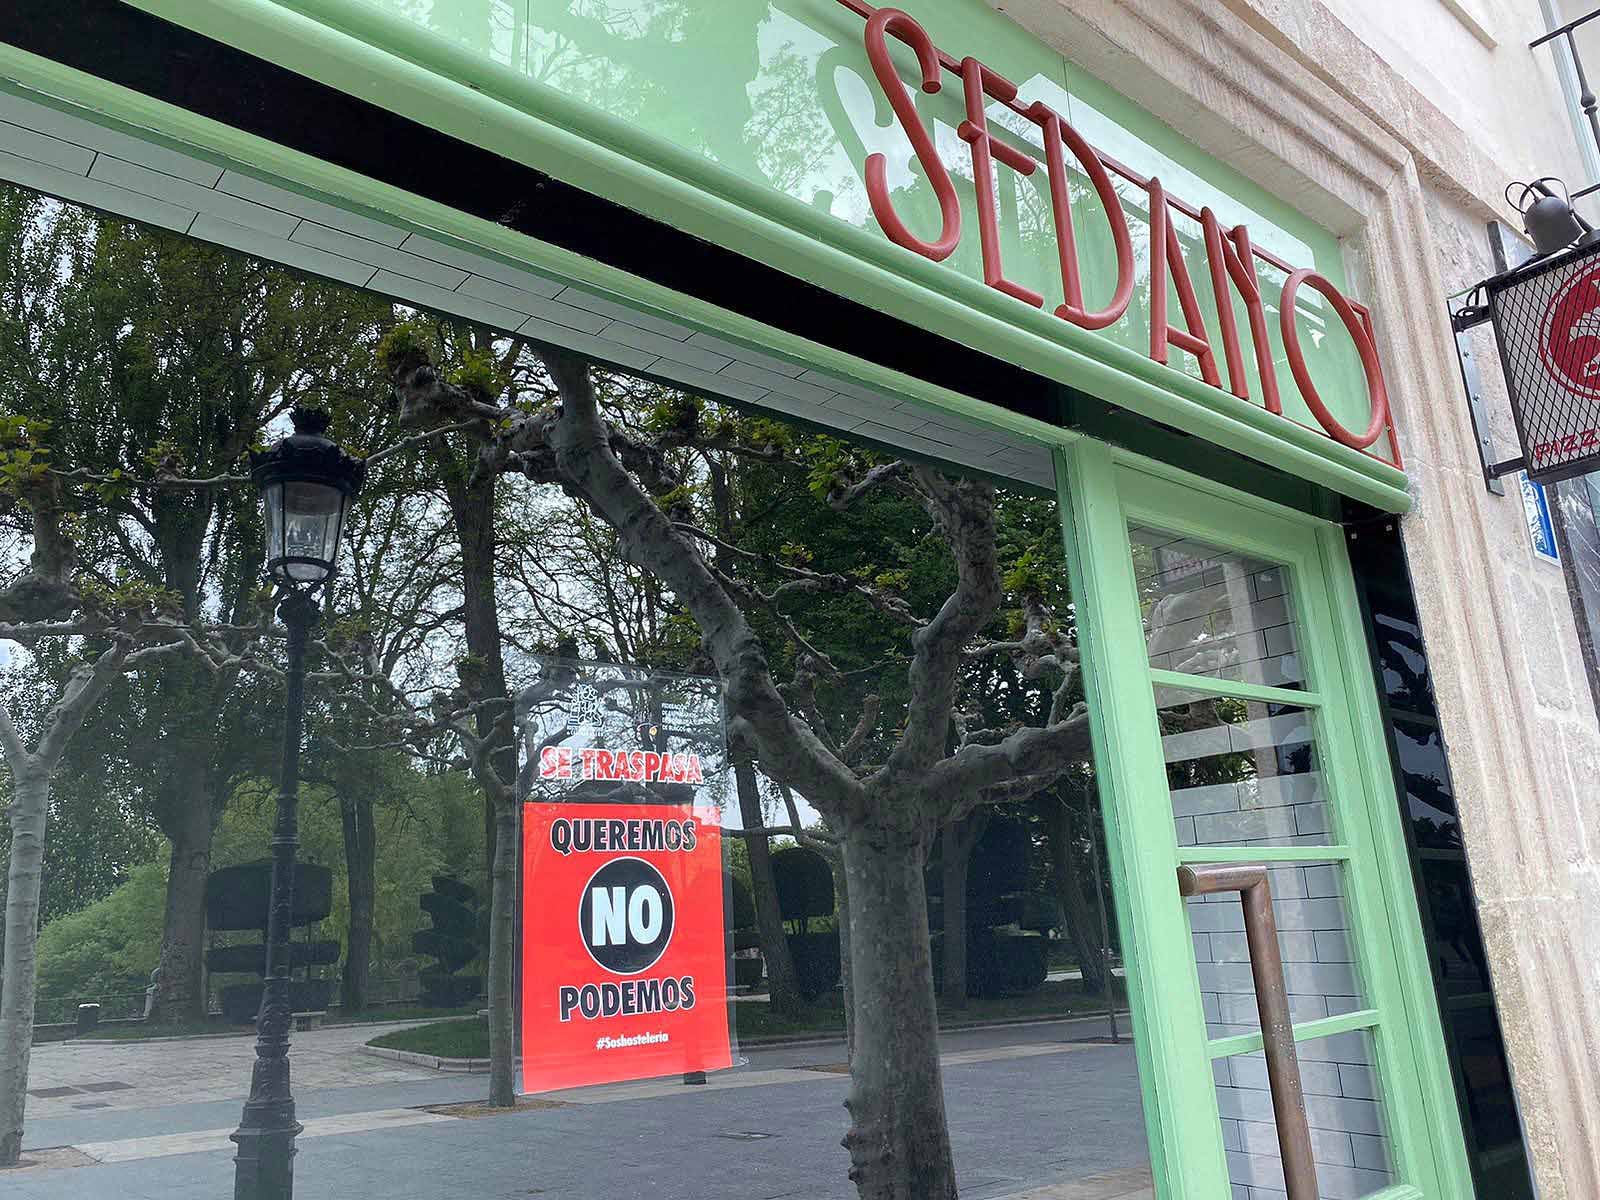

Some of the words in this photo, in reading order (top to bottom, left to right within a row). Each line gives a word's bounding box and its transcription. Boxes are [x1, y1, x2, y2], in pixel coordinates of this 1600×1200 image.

[864, 7, 1387, 449] SEDANO
[539, 745, 573, 779] SE
[580, 748, 704, 785] TRASPASA
[551, 817, 698, 857] QUEREMOS
[591, 884, 663, 947] NO
[559, 975, 697, 1023] PODEMOS
